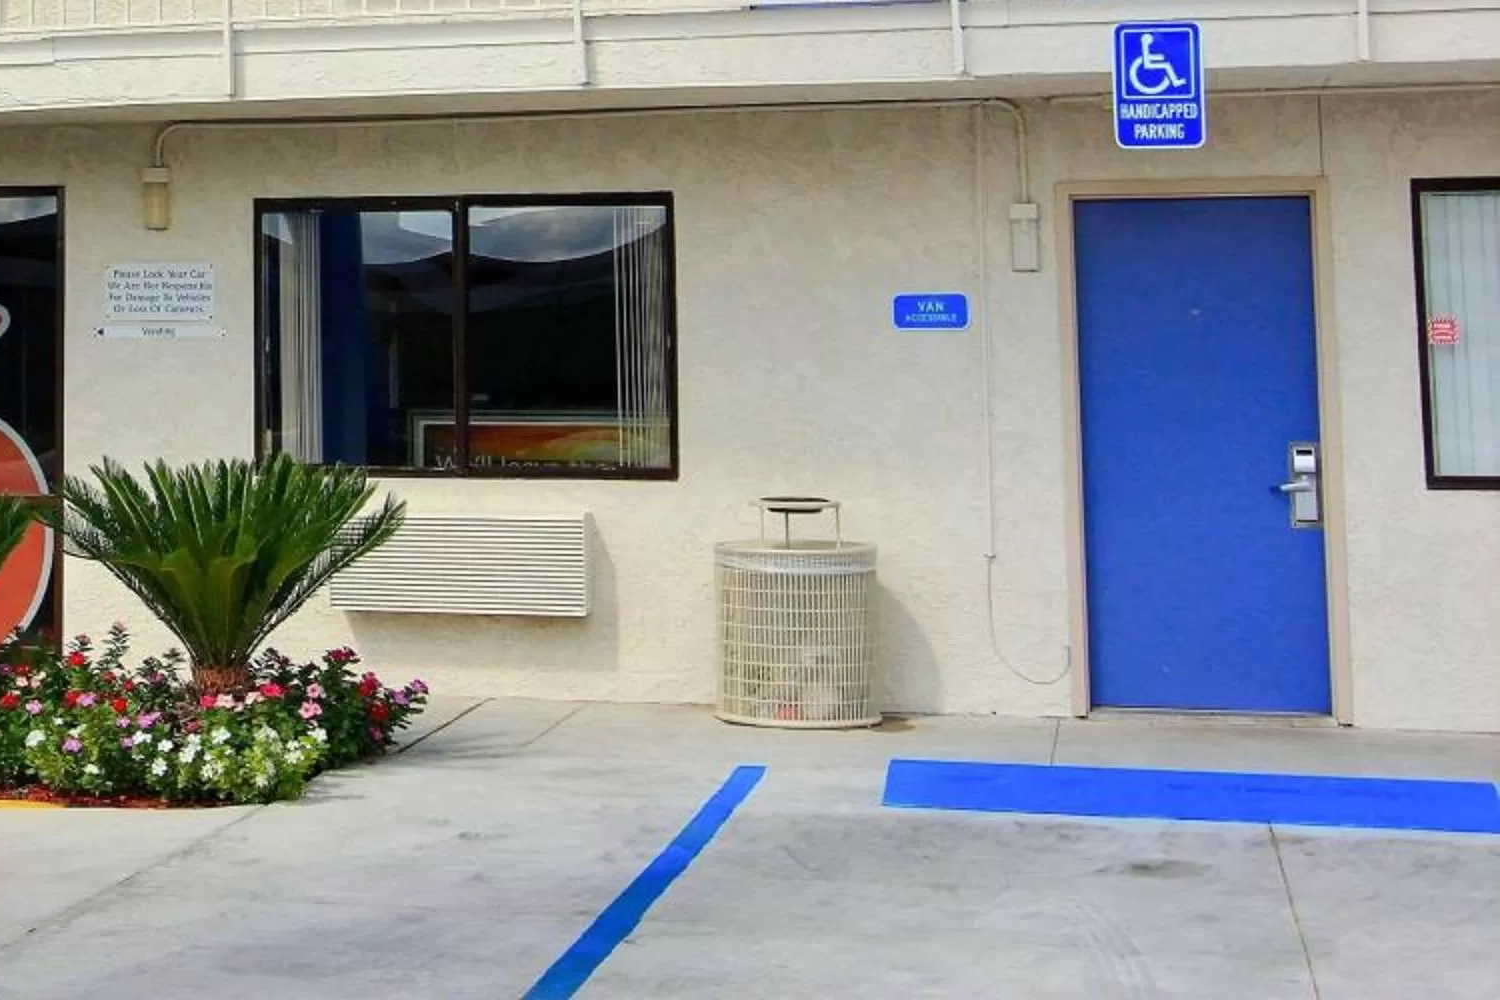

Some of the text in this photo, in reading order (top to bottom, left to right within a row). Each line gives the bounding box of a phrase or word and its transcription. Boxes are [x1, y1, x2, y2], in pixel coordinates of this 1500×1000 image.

[1120, 103, 1198, 119] HANDICAPPED
[1133, 123, 1185, 140] PARKING
[143, 269, 164, 279] Lock
[167, 269, 187, 279] Your
[189, 269, 206, 279] Car
[124, 281, 141, 290] Are
[917, 301, 946, 312] VAN
[141, 327, 177, 339] Vending
